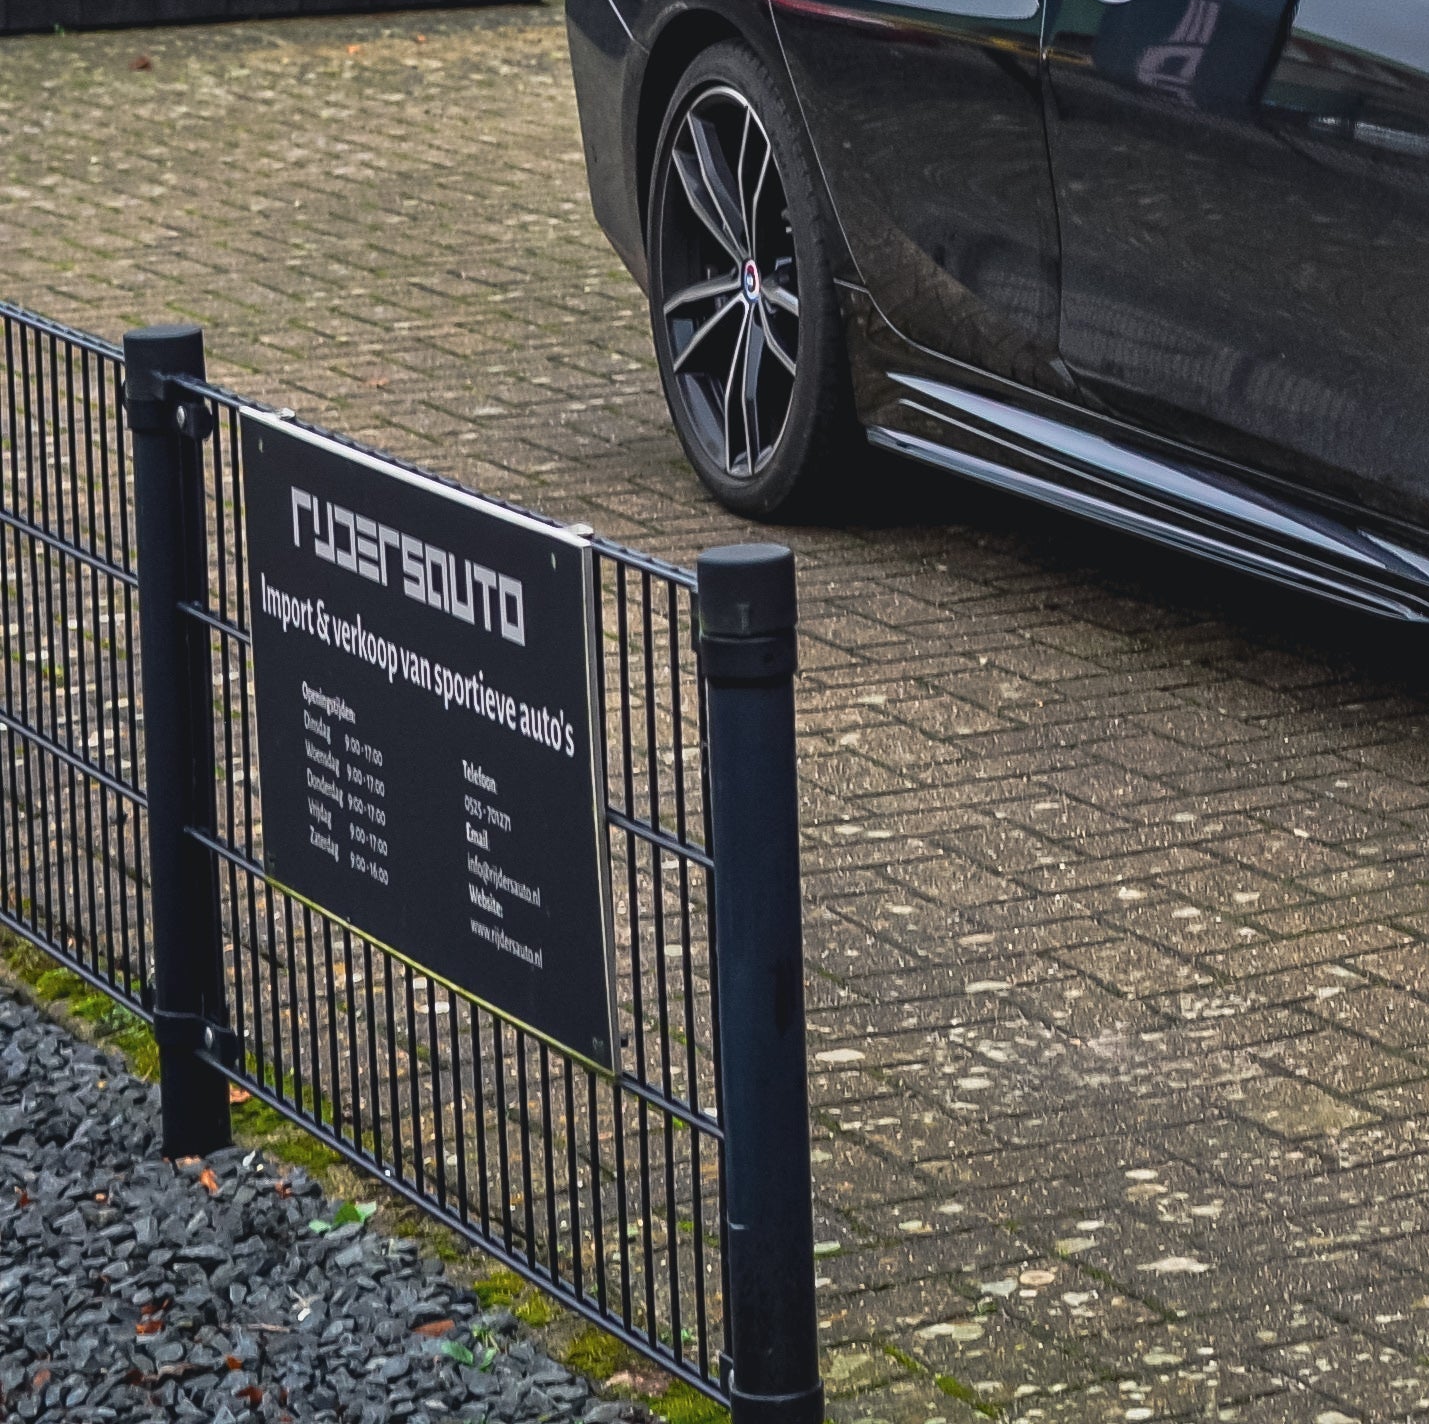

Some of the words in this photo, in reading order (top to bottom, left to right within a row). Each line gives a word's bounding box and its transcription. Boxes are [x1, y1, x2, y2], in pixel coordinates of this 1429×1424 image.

[261, 573, 314, 634] Import
[316, 599, 331, 645] &
[332, 614, 397, 683] verkoop
[401, 647, 431, 690] van
[434, 670, 516, 731] sportieve
[520, 702, 575, 757] auto's
[467, 851, 541, 908] info@rijdersauto.nl
[470, 918, 543, 969] www.rijdersauto.nl
